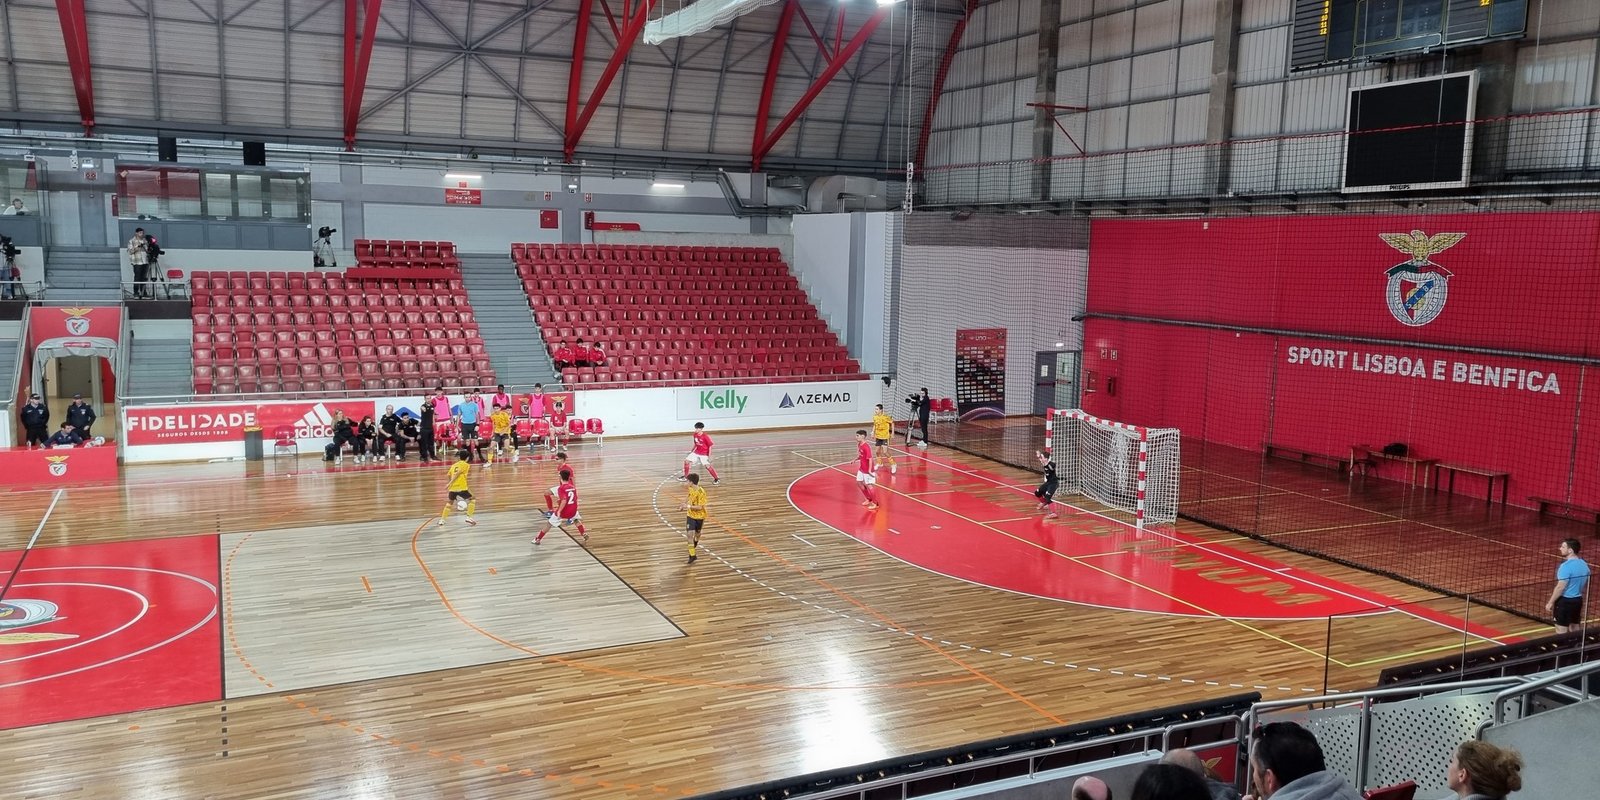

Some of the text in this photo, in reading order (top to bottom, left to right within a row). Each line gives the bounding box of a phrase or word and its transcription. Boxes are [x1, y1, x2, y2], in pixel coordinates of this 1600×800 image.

[1287, 345, 1561, 395] SPORT LISBOA E BENFICA
[700, 389, 748, 413] Kelly
[797, 392, 851, 405] AZEMAD
[128, 412, 255, 431] FIDELIDADE
[294, 425, 335, 438] dida
[567, 491, 575, 504] 2
